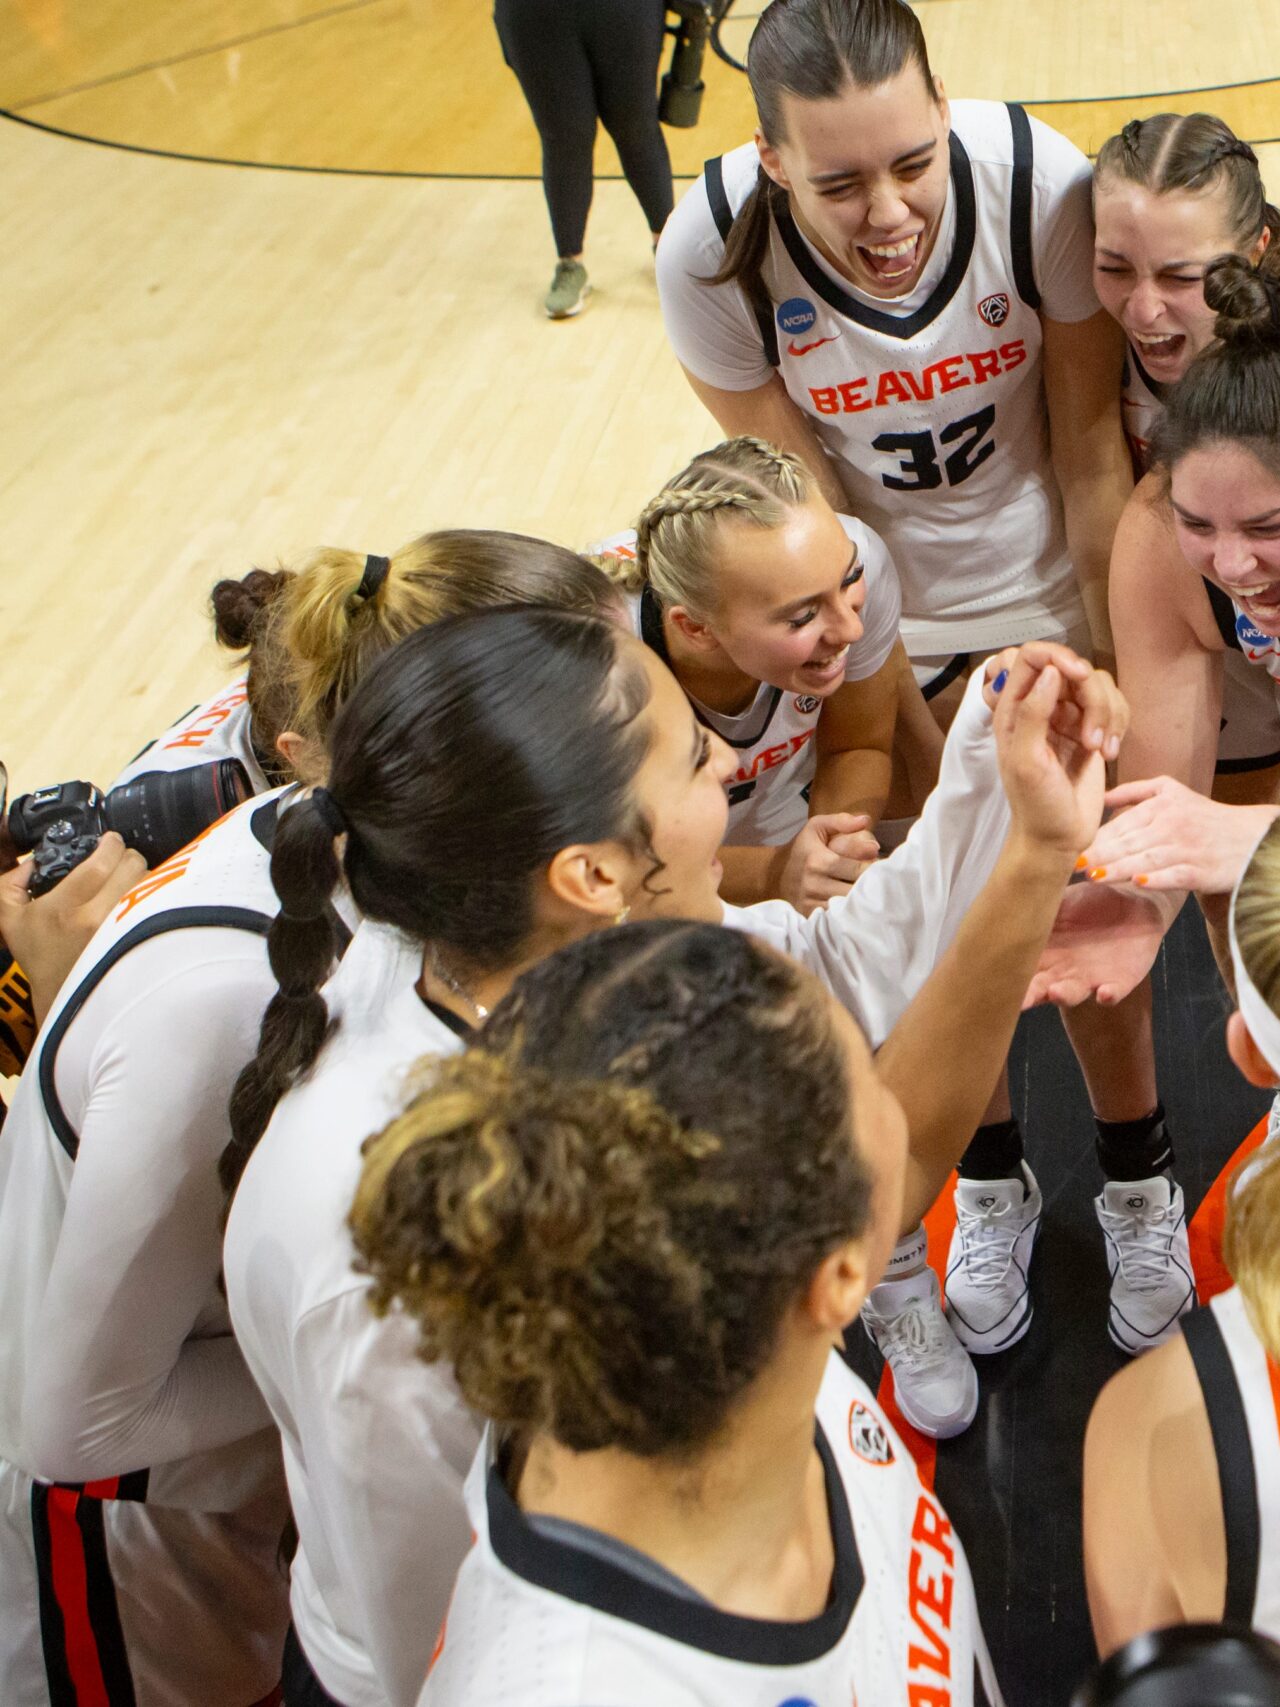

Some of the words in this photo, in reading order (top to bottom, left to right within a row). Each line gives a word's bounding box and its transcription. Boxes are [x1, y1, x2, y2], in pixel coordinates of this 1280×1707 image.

[980, 296, 1008, 320] PAC
[990, 308, 1004, 323] 12
[783, 312, 814, 328] NCAA
[808, 339, 1027, 414] BEAVERS
[871, 404, 996, 490] 32
[1242, 627, 1274, 640] NCA
